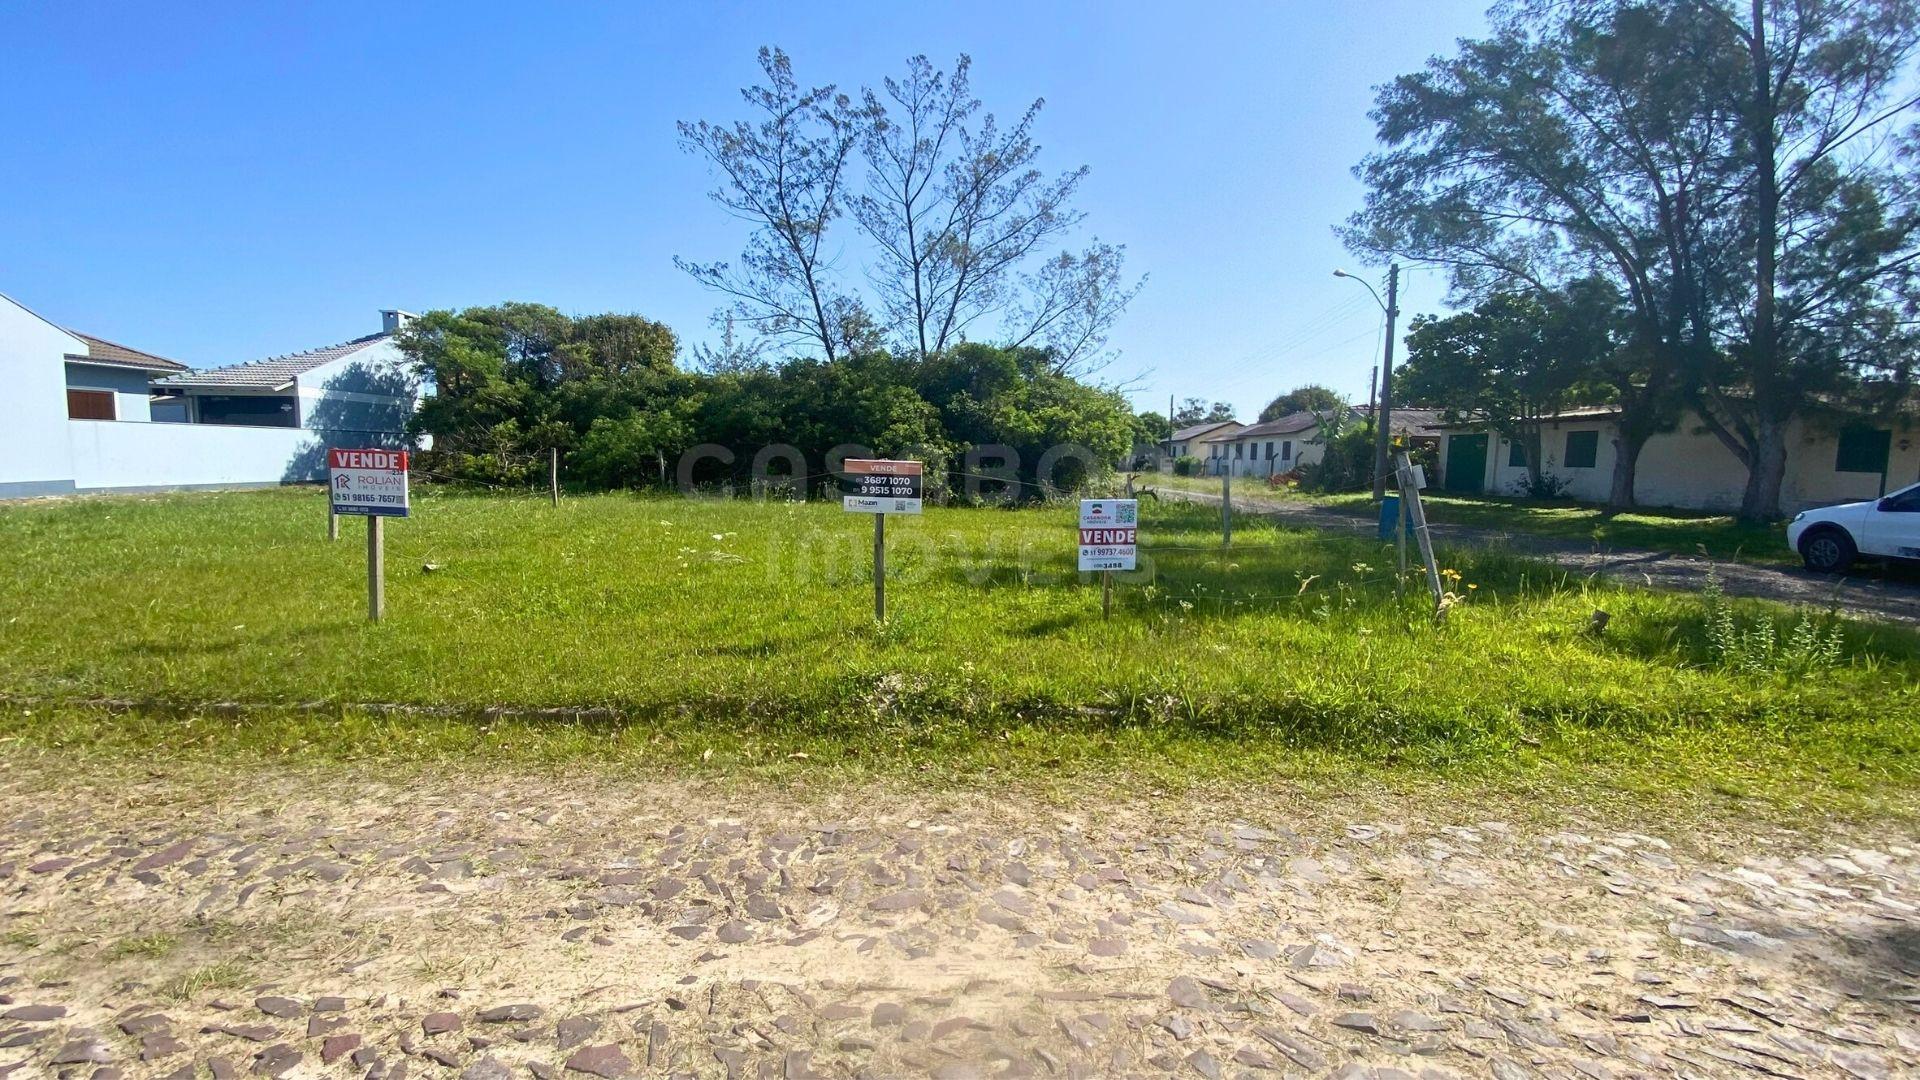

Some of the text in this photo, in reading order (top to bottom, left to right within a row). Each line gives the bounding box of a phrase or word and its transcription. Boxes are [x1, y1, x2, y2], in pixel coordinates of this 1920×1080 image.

[336, 452, 399, 469] VENDE
[358, 475, 400, 485] ROLIAN
[864, 476, 887, 484] 3687
[889, 477, 910, 485] 1070
[861, 486, 867, 494] 9
[869, 486, 889, 494] 9515
[892, 487, 912, 495] 1070
[342, 493, 395, 503] 51 98165-7657
[1082, 530, 1135, 543] VENDE
